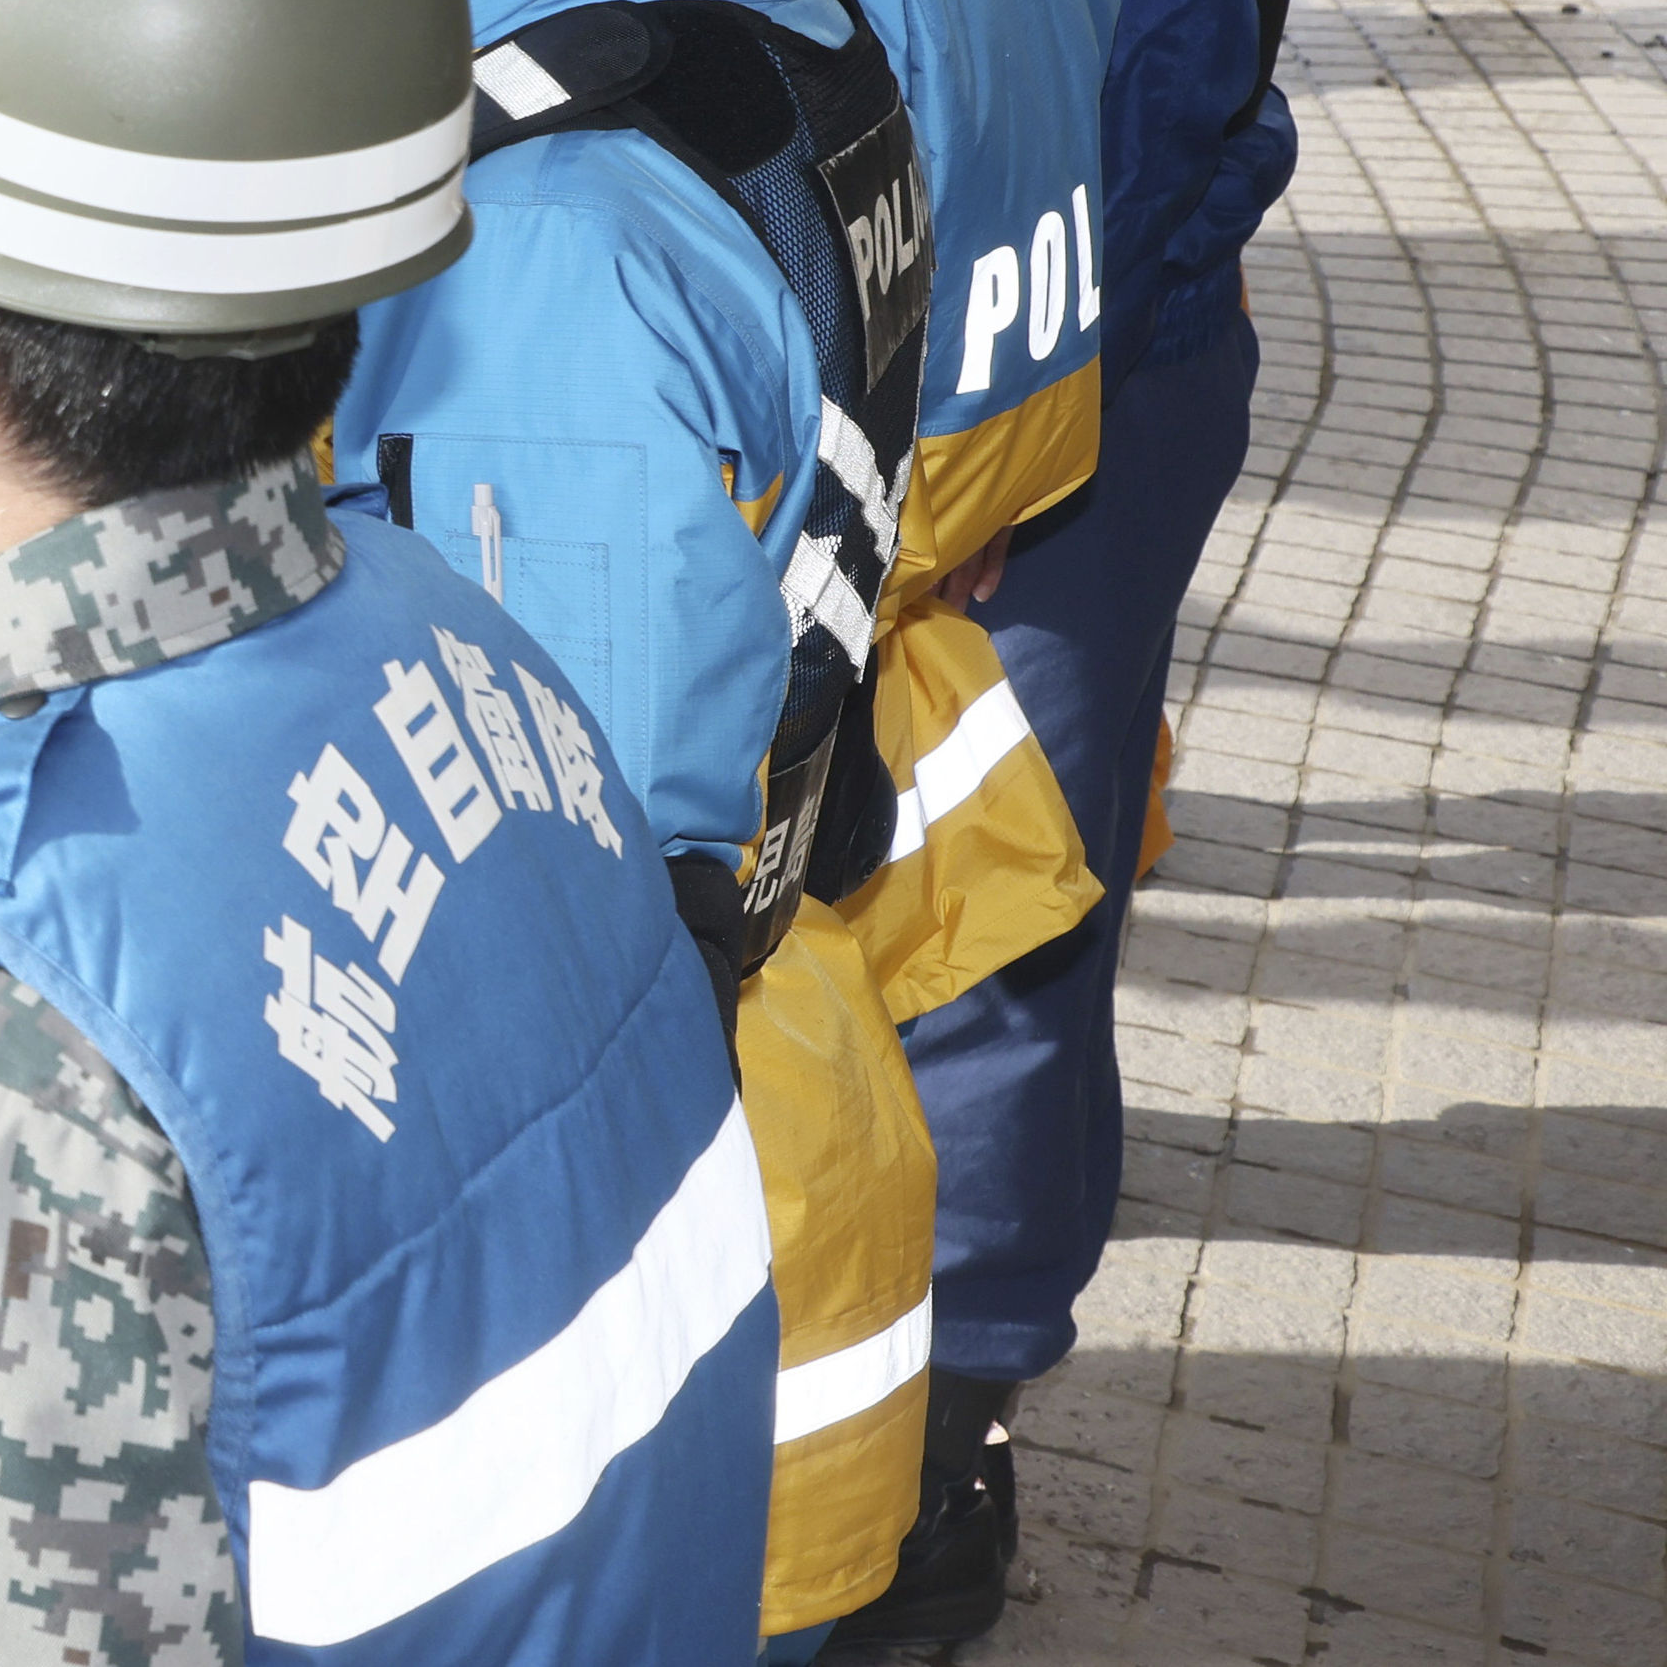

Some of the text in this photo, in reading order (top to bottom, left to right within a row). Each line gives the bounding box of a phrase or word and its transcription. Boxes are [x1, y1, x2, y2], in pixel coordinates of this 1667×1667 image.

[262, 623, 624, 1145] 航空自衛隊
